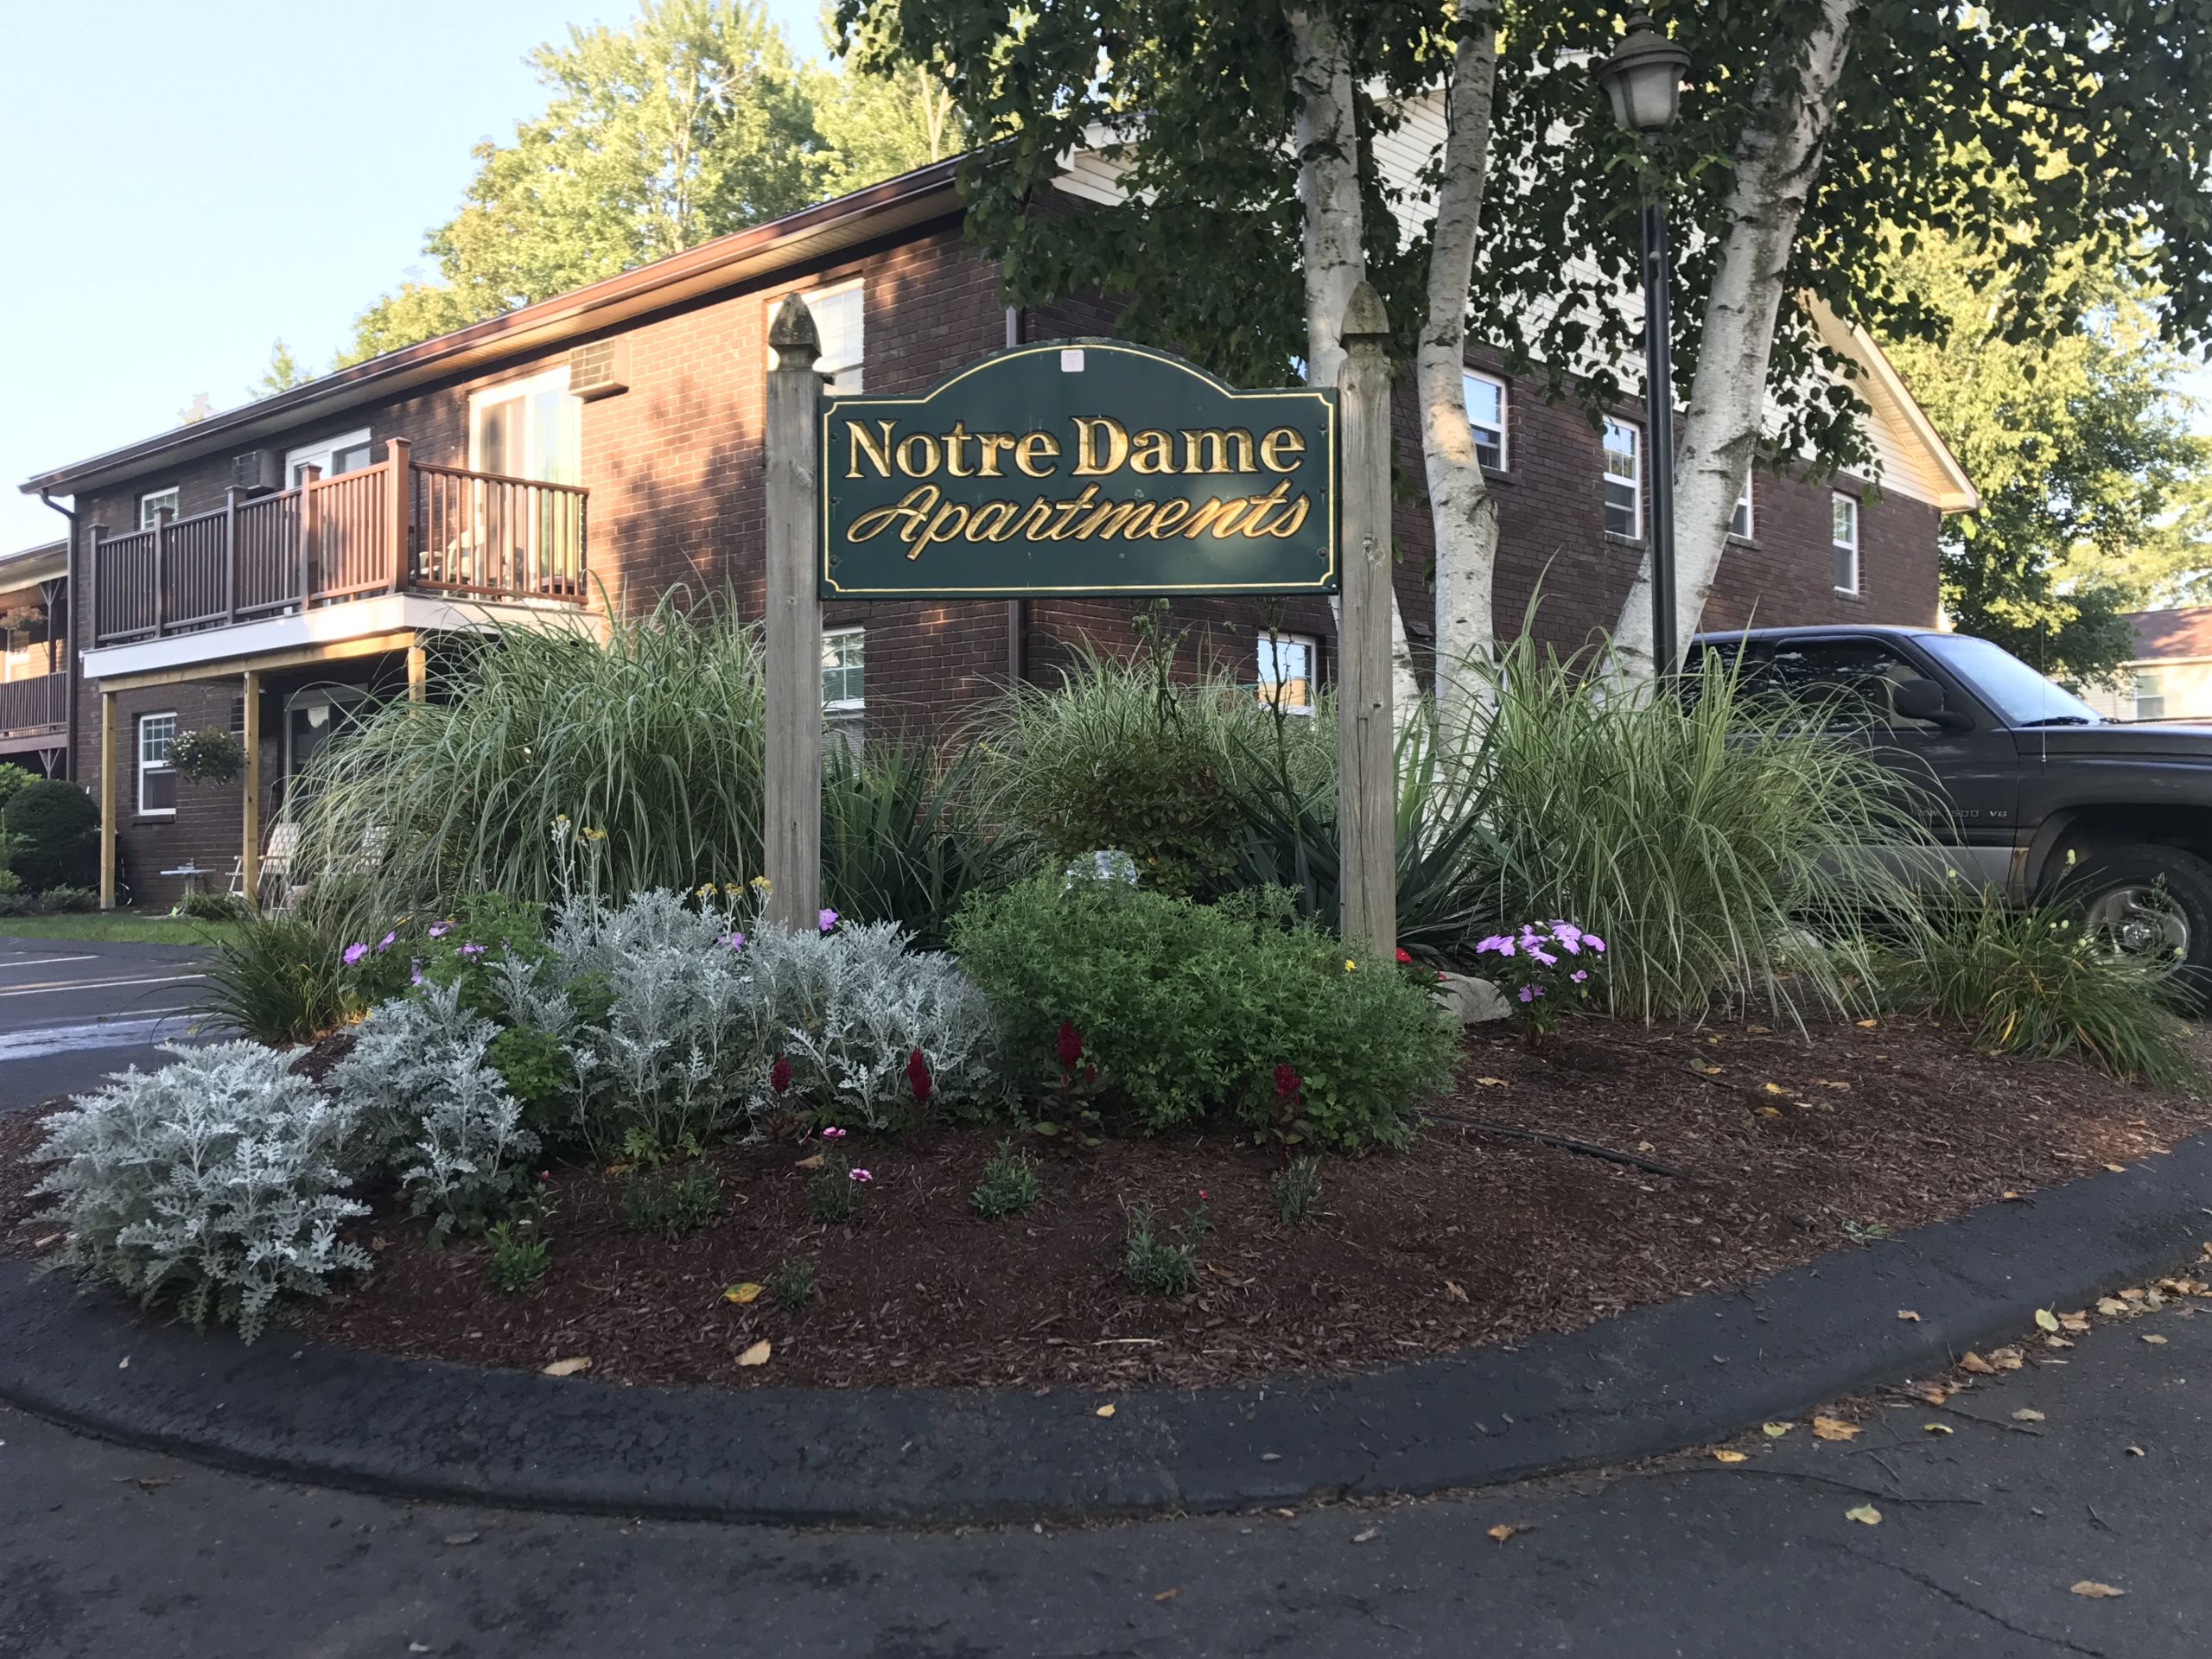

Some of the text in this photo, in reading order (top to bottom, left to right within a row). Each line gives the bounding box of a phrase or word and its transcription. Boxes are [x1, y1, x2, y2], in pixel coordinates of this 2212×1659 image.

[843, 415, 1307, 480] Notre Dame
[846, 478, 1311, 562] Apartments
